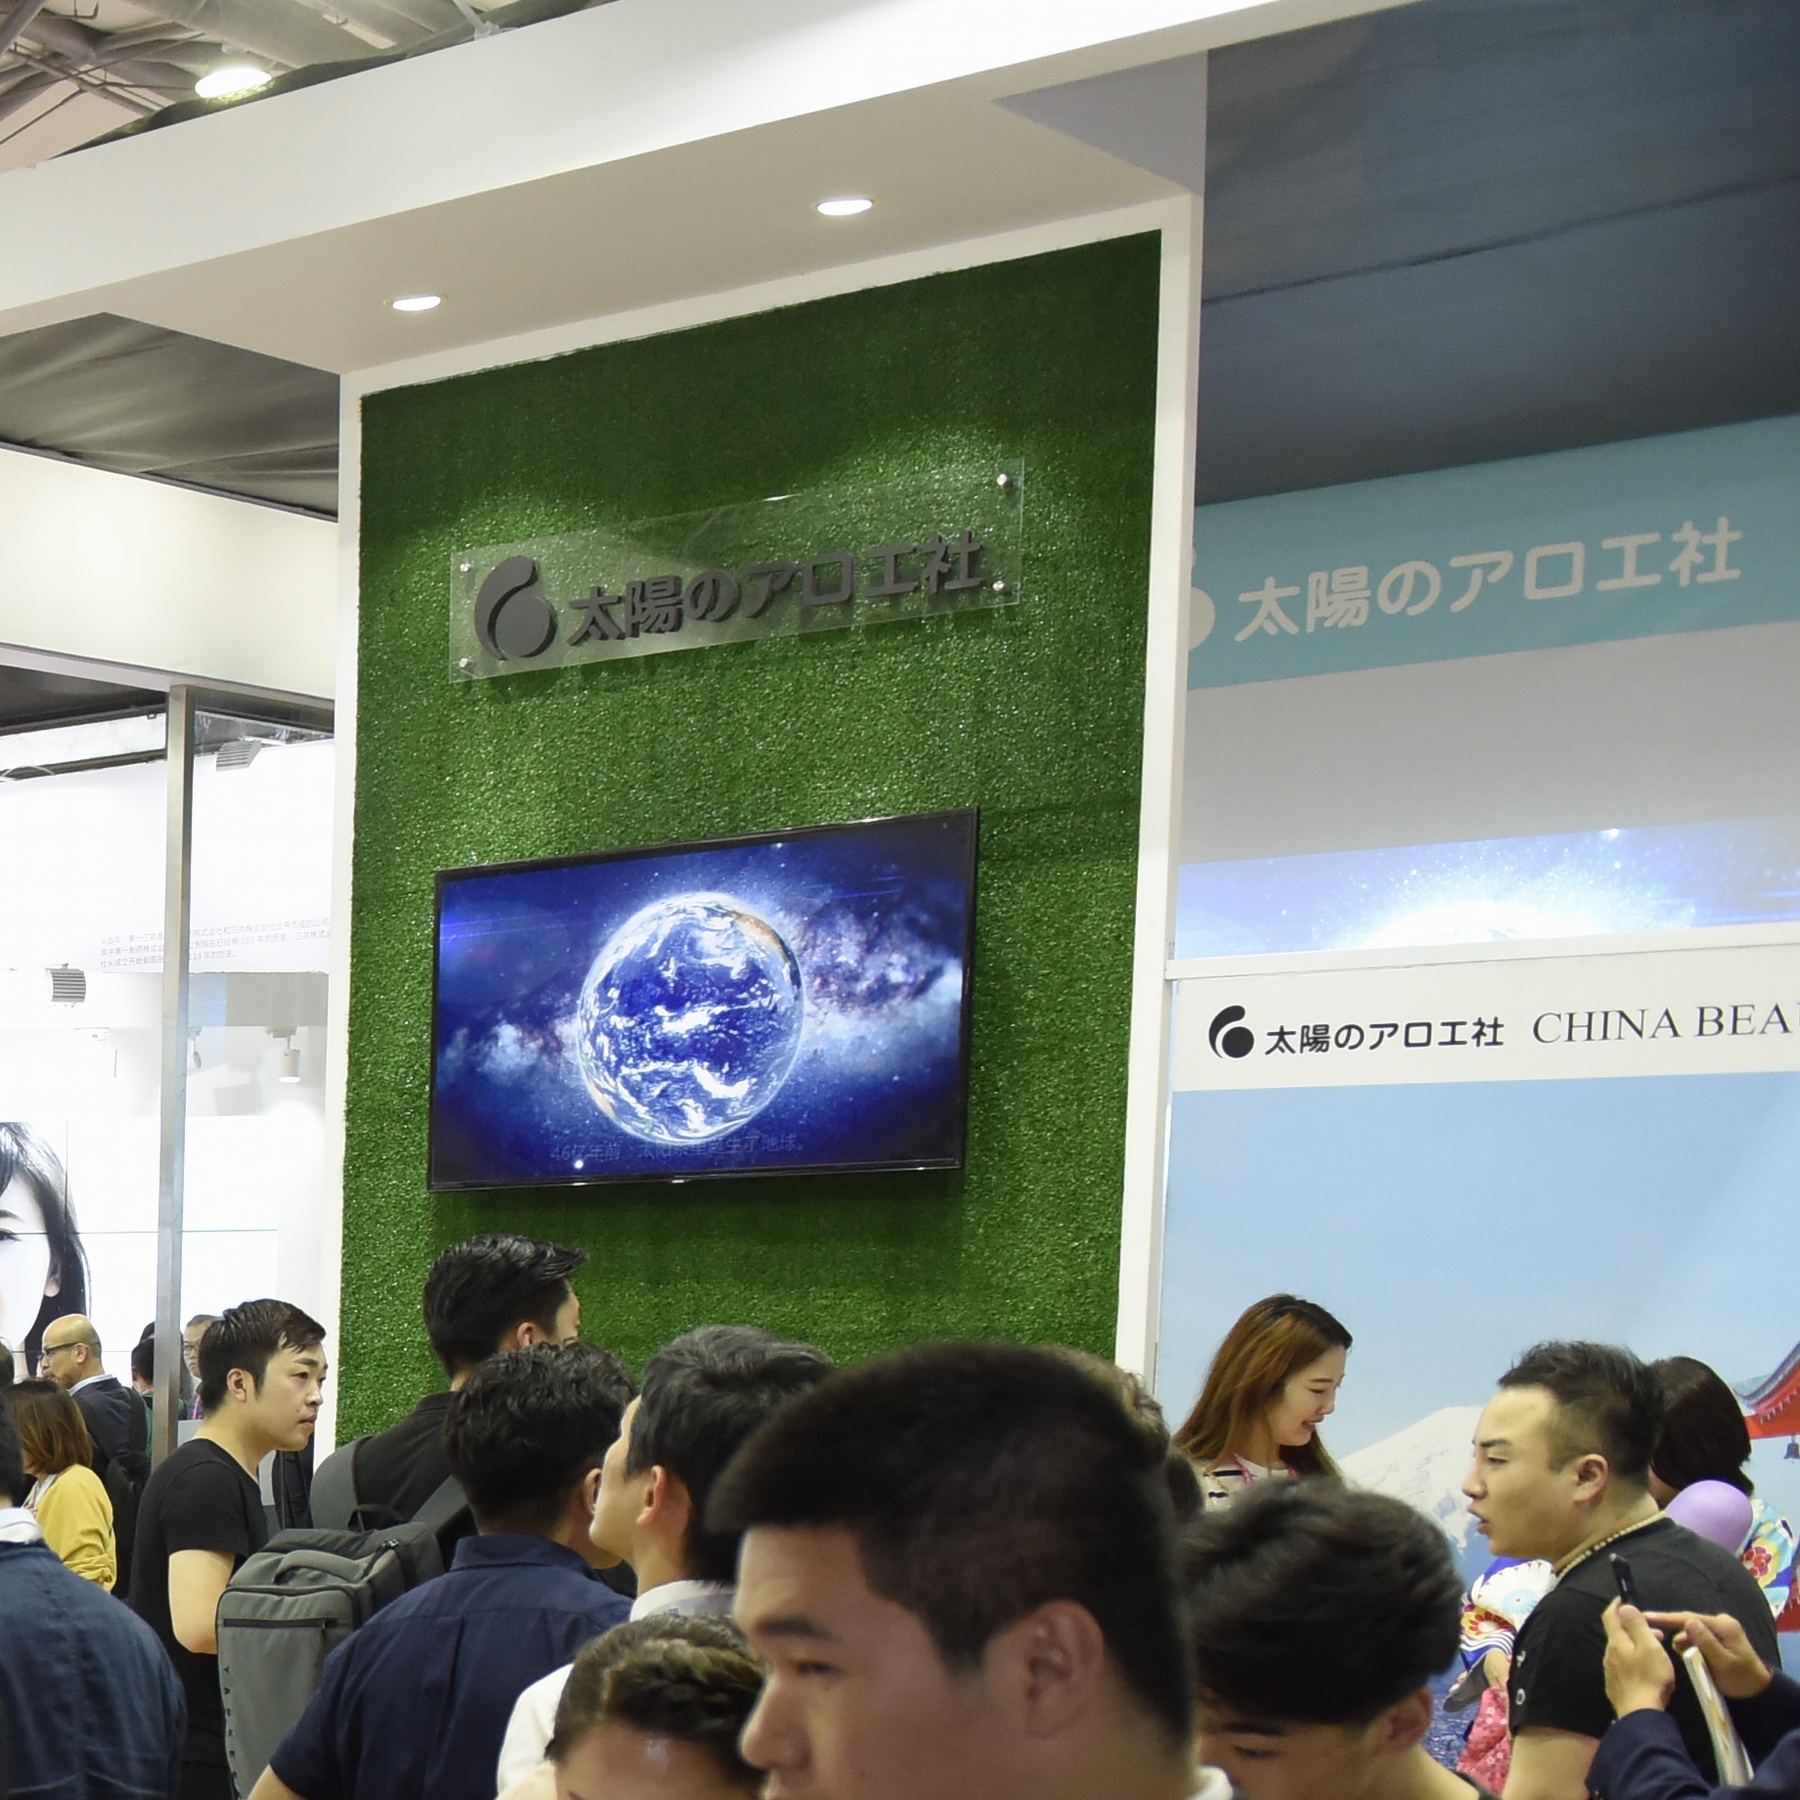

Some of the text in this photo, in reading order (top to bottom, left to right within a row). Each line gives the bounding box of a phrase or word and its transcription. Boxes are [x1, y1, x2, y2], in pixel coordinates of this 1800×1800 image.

[567, 529, 984, 647] 太陽のアロエ社
[1233, 515, 1743, 643] 太陽のアロエ社
[1264, 1001, 1800, 1057] 太陽のアロエ社 CHINA BEA
